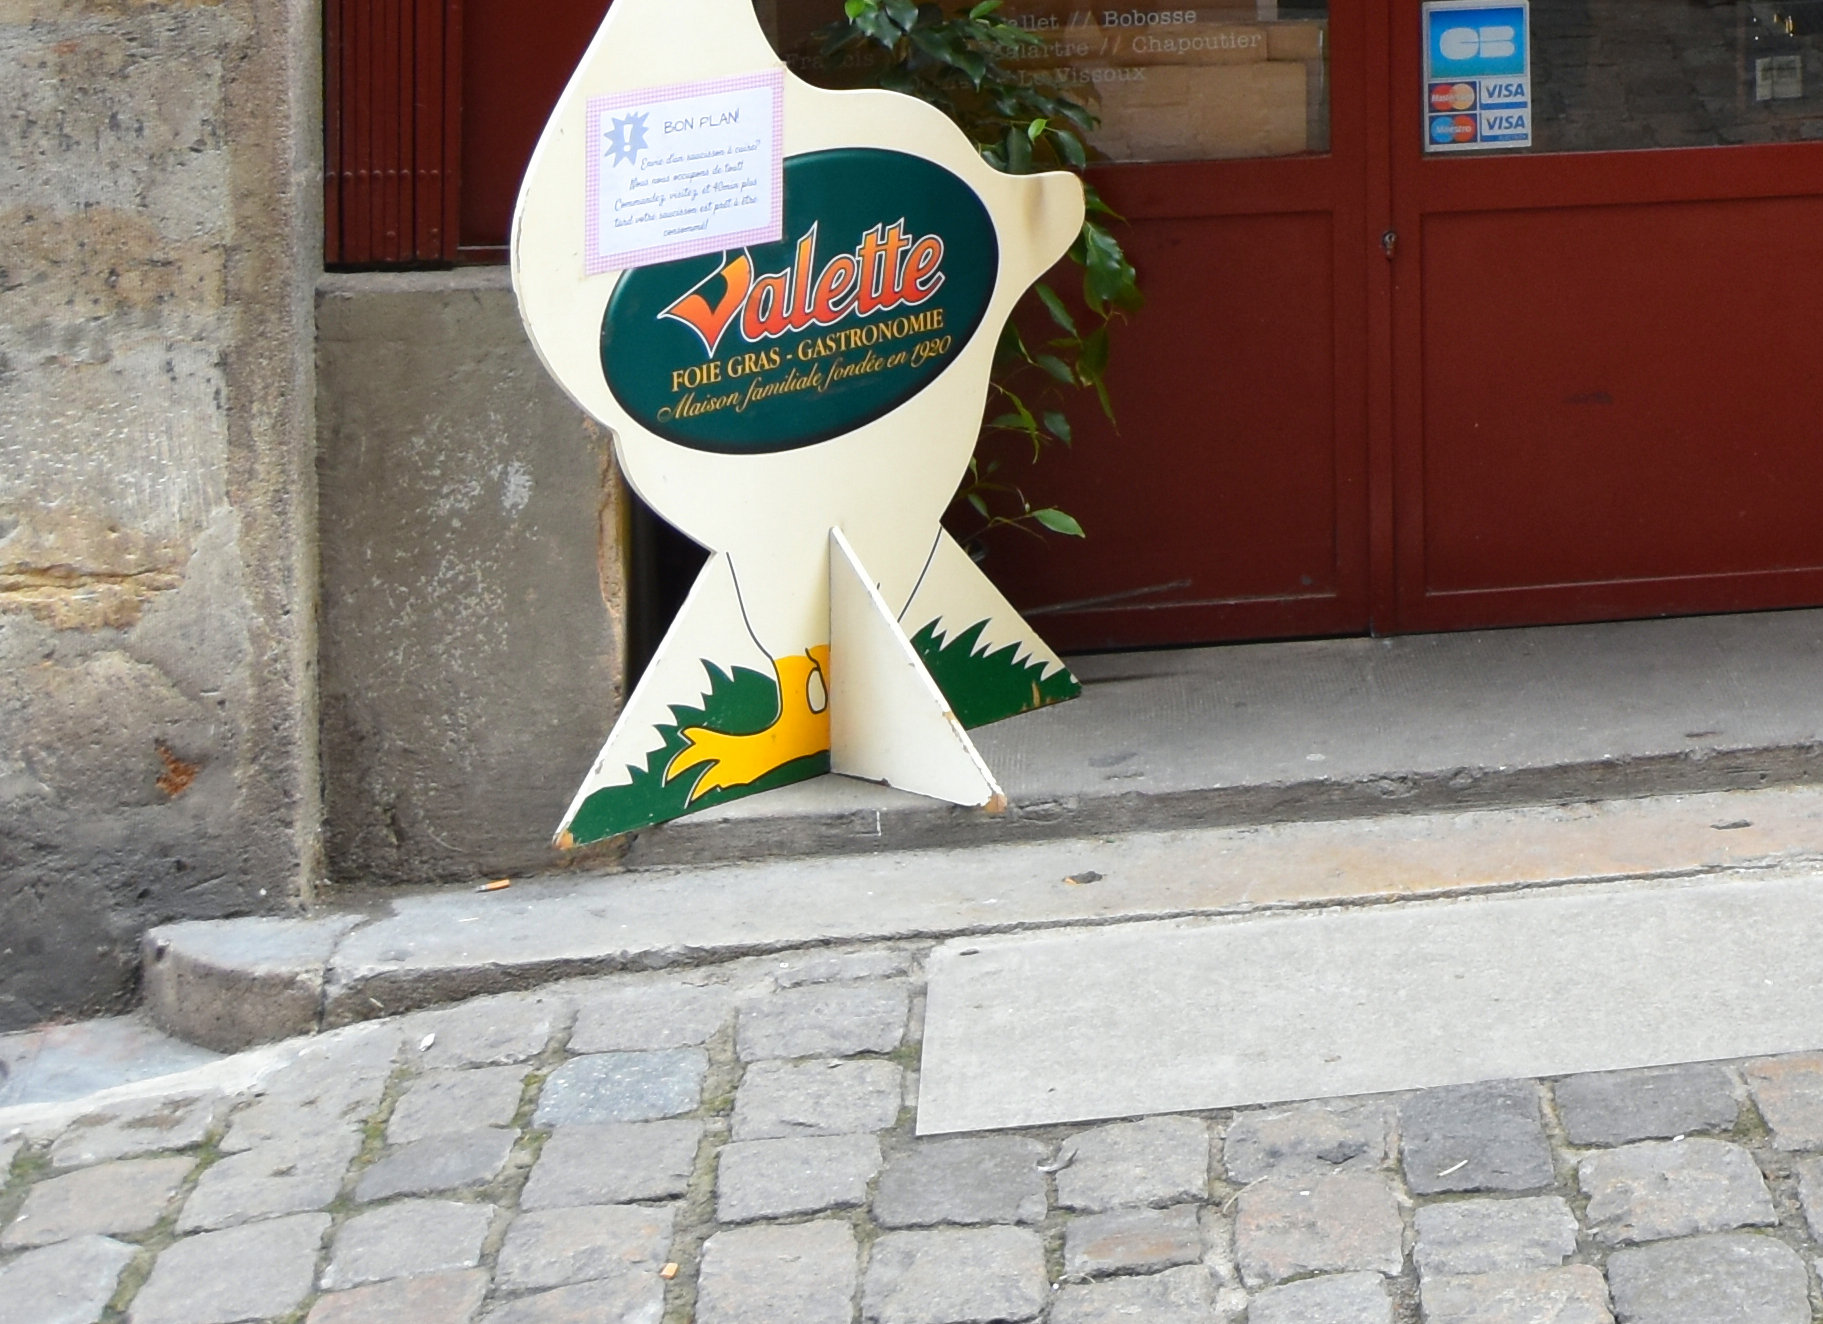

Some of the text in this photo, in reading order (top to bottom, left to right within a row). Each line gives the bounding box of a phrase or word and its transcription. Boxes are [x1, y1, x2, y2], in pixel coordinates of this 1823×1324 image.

[1103, 7, 1197, 29] Bobosse
[1486, 83, 1525, 98] VISA
[664, 117, 693, 134] BON
[1487, 115, 1526, 130] VISA
[656, 216, 945, 359] Valette
[672, 309, 944, 392] FOIE GRAS GASTRONOMIE
[657, 335, 952, 423] Maison familiale fondée en 1920
